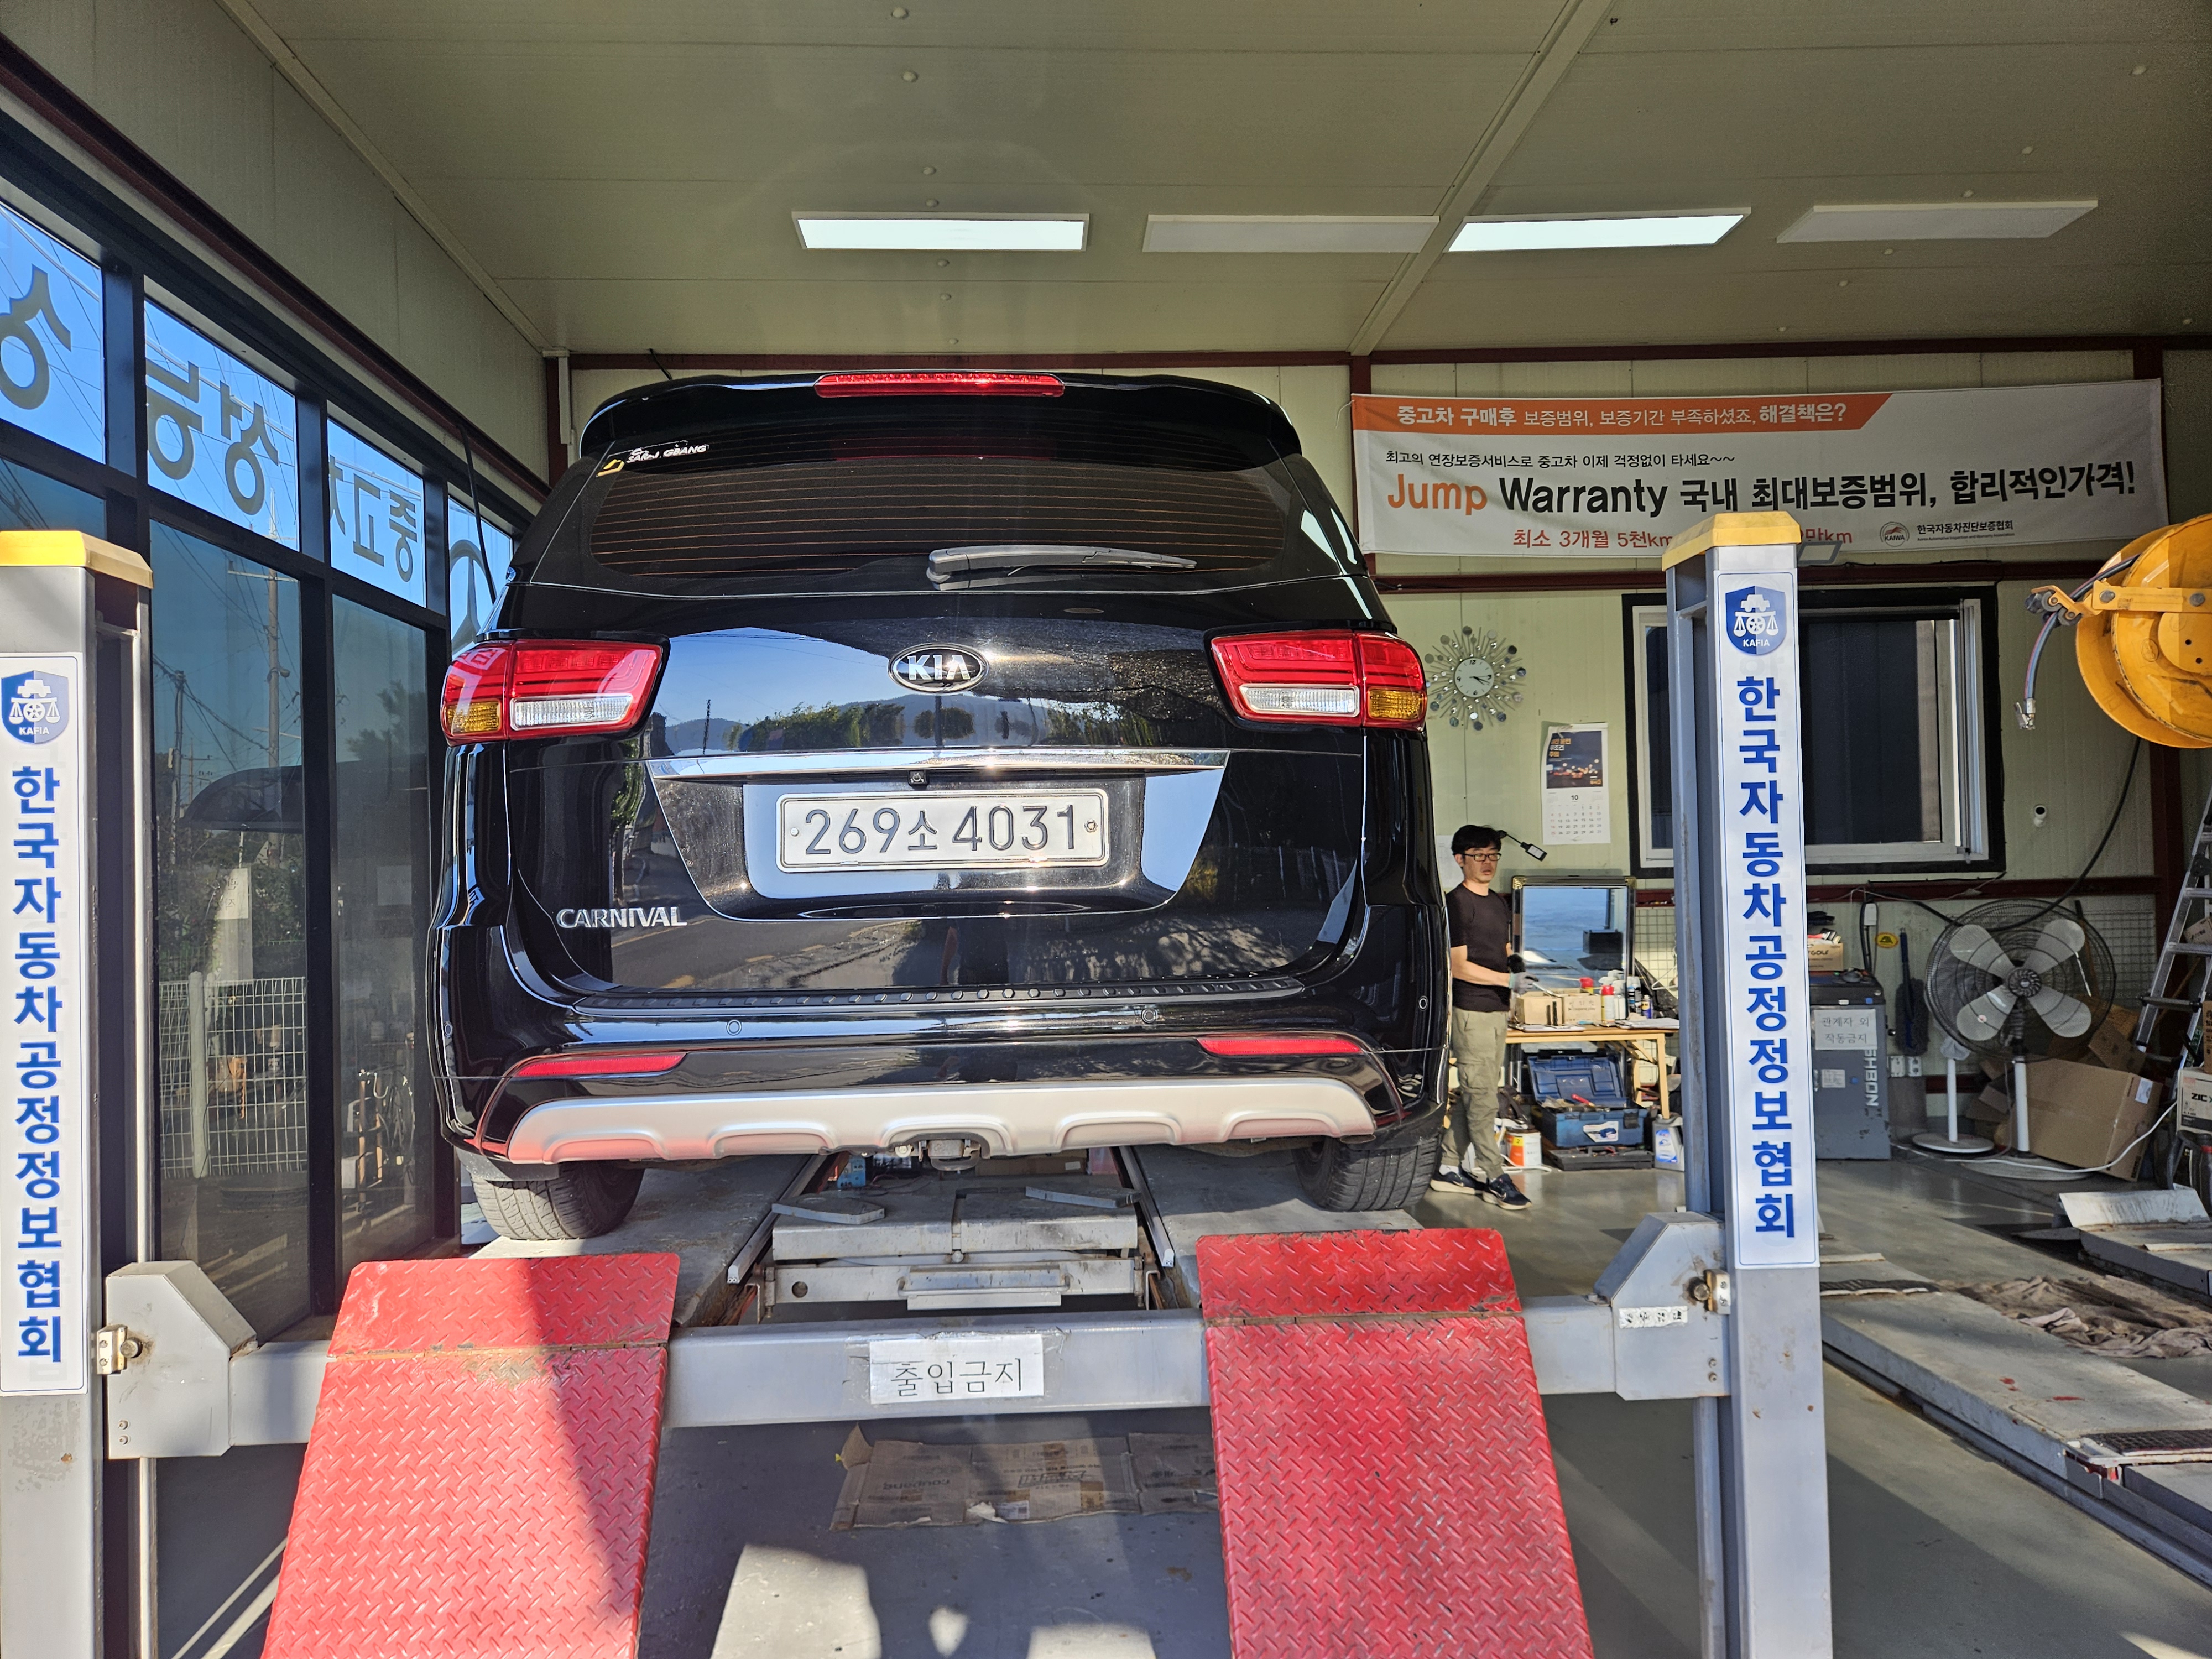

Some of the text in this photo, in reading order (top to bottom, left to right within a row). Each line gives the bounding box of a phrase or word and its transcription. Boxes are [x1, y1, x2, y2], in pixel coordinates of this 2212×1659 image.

[1397, 403, 1846, 427] 중고차 구매후 보증범위, 보증기간 부족하셨죠, 해결책은?
[1386, 451, 1423, 466] 최고의
[1428, 452, 1533, 468] 연장보증서비스로
[1537, 454, 1577, 469] 중고차
[1583, 454, 1609, 469] 이제
[1614, 453, 1666, 469] 걱정없이
[1387, 461, 2136, 517] Jump Warranty 국내 최대보증범위, 합리적인가격!
[1917, 520, 2013, 534] 한국자동차진단보증협회
[1513, 529, 1551, 549] 최소
[1559, 529, 1609, 549] 3개월
[1801, 528, 1853, 544] 만km
[907, 654, 971, 680] KIA
[19, 727, 50, 735] KAFIA
[556, 906, 687, 928] CARNIVAL
[1736, 676, 1795, 1238] 한국자동차공정정보협회
[1859, 1017, 1869, 1027] 외
[12, 766, 63, 1363] 한국자동차공정정보협회
[2192, 1092, 2207, 1102] ZIC
[891, 1358, 1021, 1397] 출입금지
